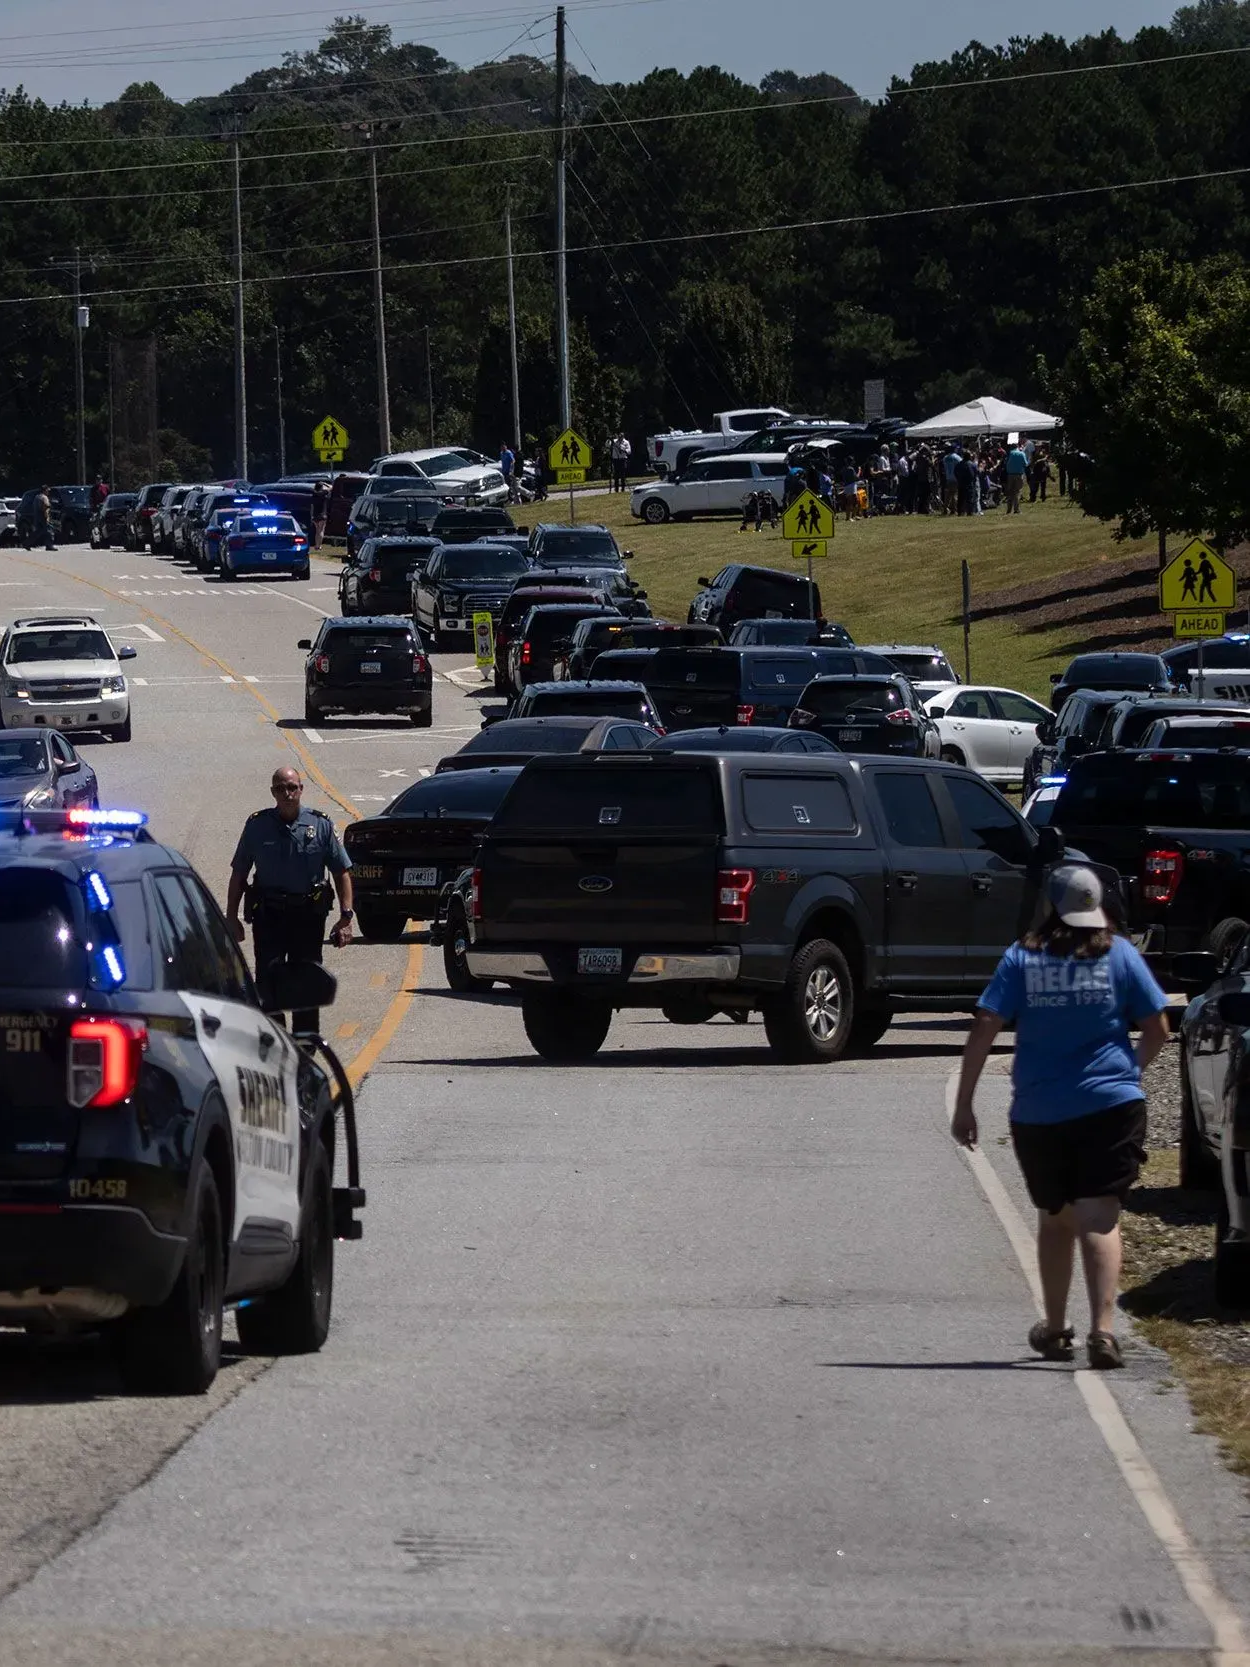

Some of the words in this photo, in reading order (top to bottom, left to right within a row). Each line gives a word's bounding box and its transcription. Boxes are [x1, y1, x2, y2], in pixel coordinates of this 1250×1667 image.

[561, 473, 581, 481] AHEAD
[1181, 619, 1218, 631] AHEAD
[1026, 994, 1068, 1007] Since
[5, 1029, 42, 1052] 911
[236, 1066, 286, 1135] SHERIFF
[68, 1179, 127, 1200] 10458
